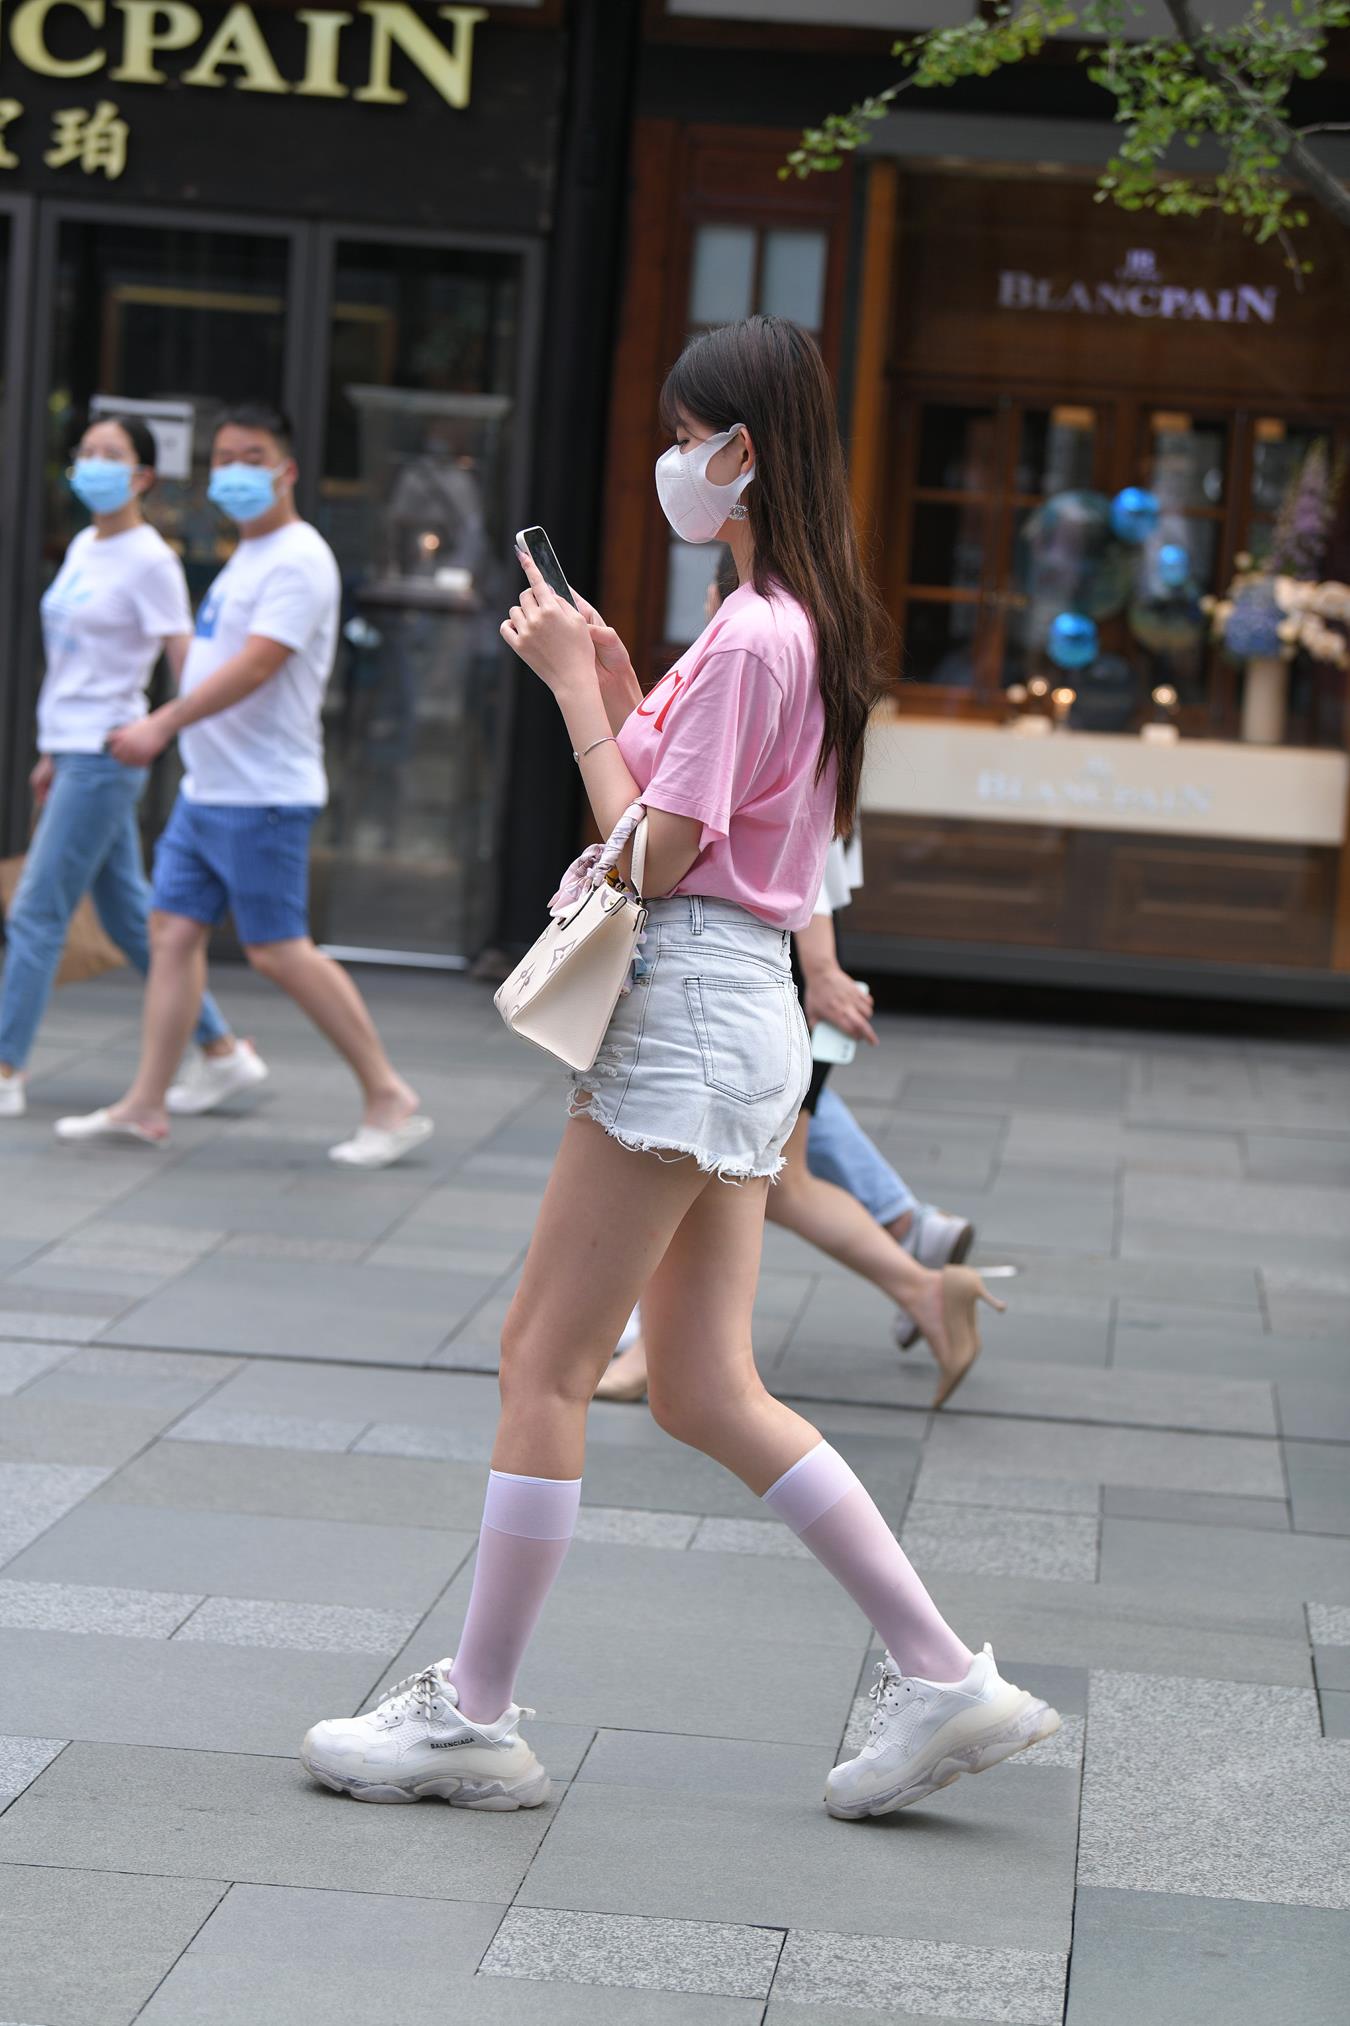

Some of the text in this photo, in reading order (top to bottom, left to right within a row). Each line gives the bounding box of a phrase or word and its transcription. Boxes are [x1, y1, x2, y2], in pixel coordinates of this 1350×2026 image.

[10, 0, 487, 108] CPAIN
[998, 270, 1277, 324] BLANCPAIN
[430, 1737, 475, 1749] BALENCIAGA
